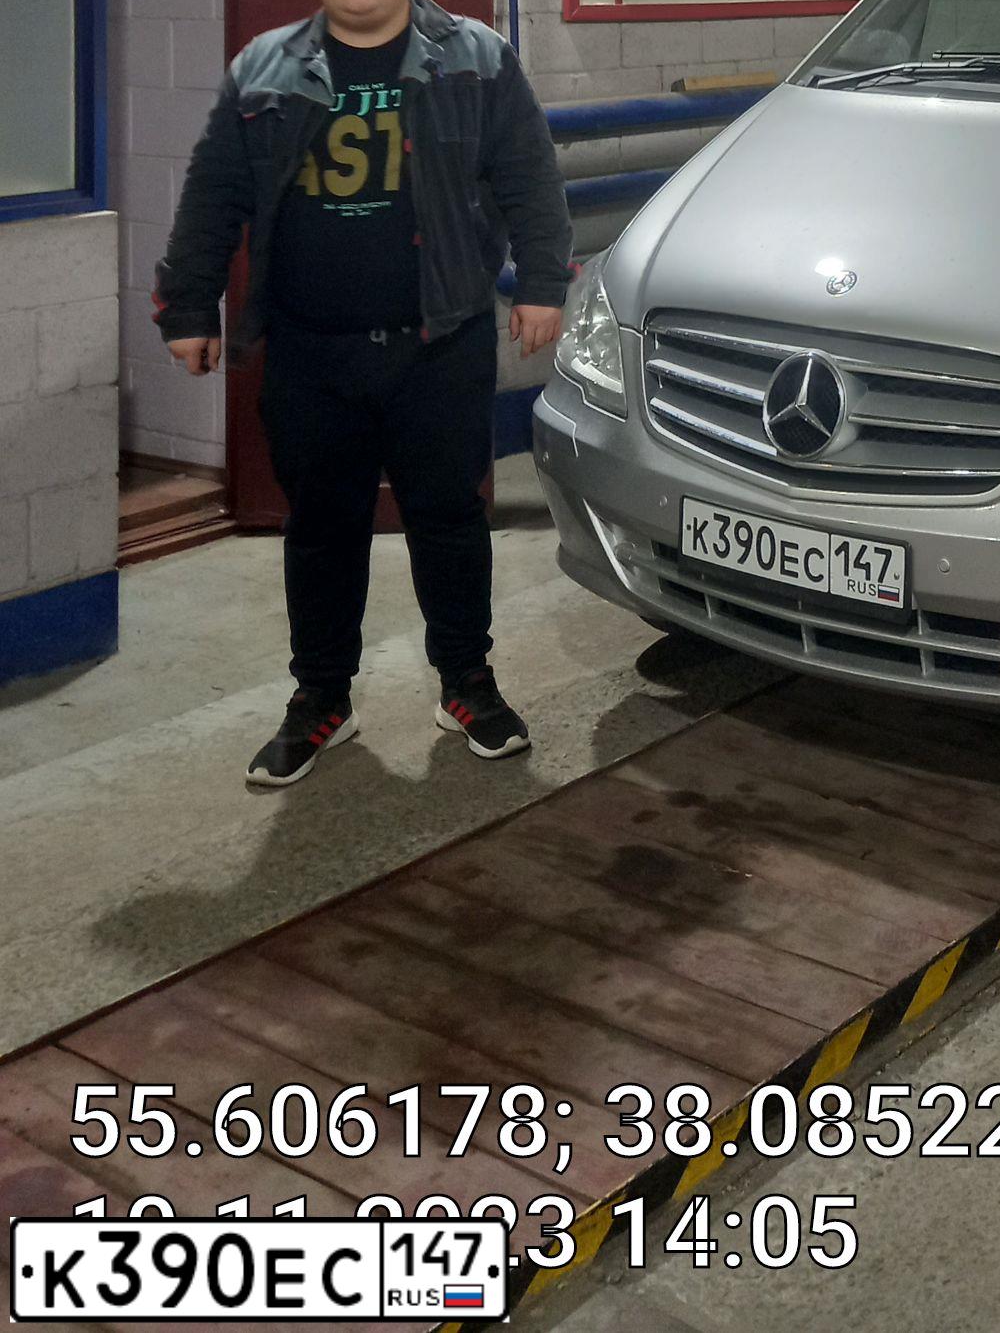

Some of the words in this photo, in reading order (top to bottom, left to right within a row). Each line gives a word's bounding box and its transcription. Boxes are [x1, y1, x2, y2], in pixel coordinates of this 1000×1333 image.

[692, 512, 825, 583] К390ЕС
[834, 540, 892, 584] 147
[847, 578, 877, 597] RUS
